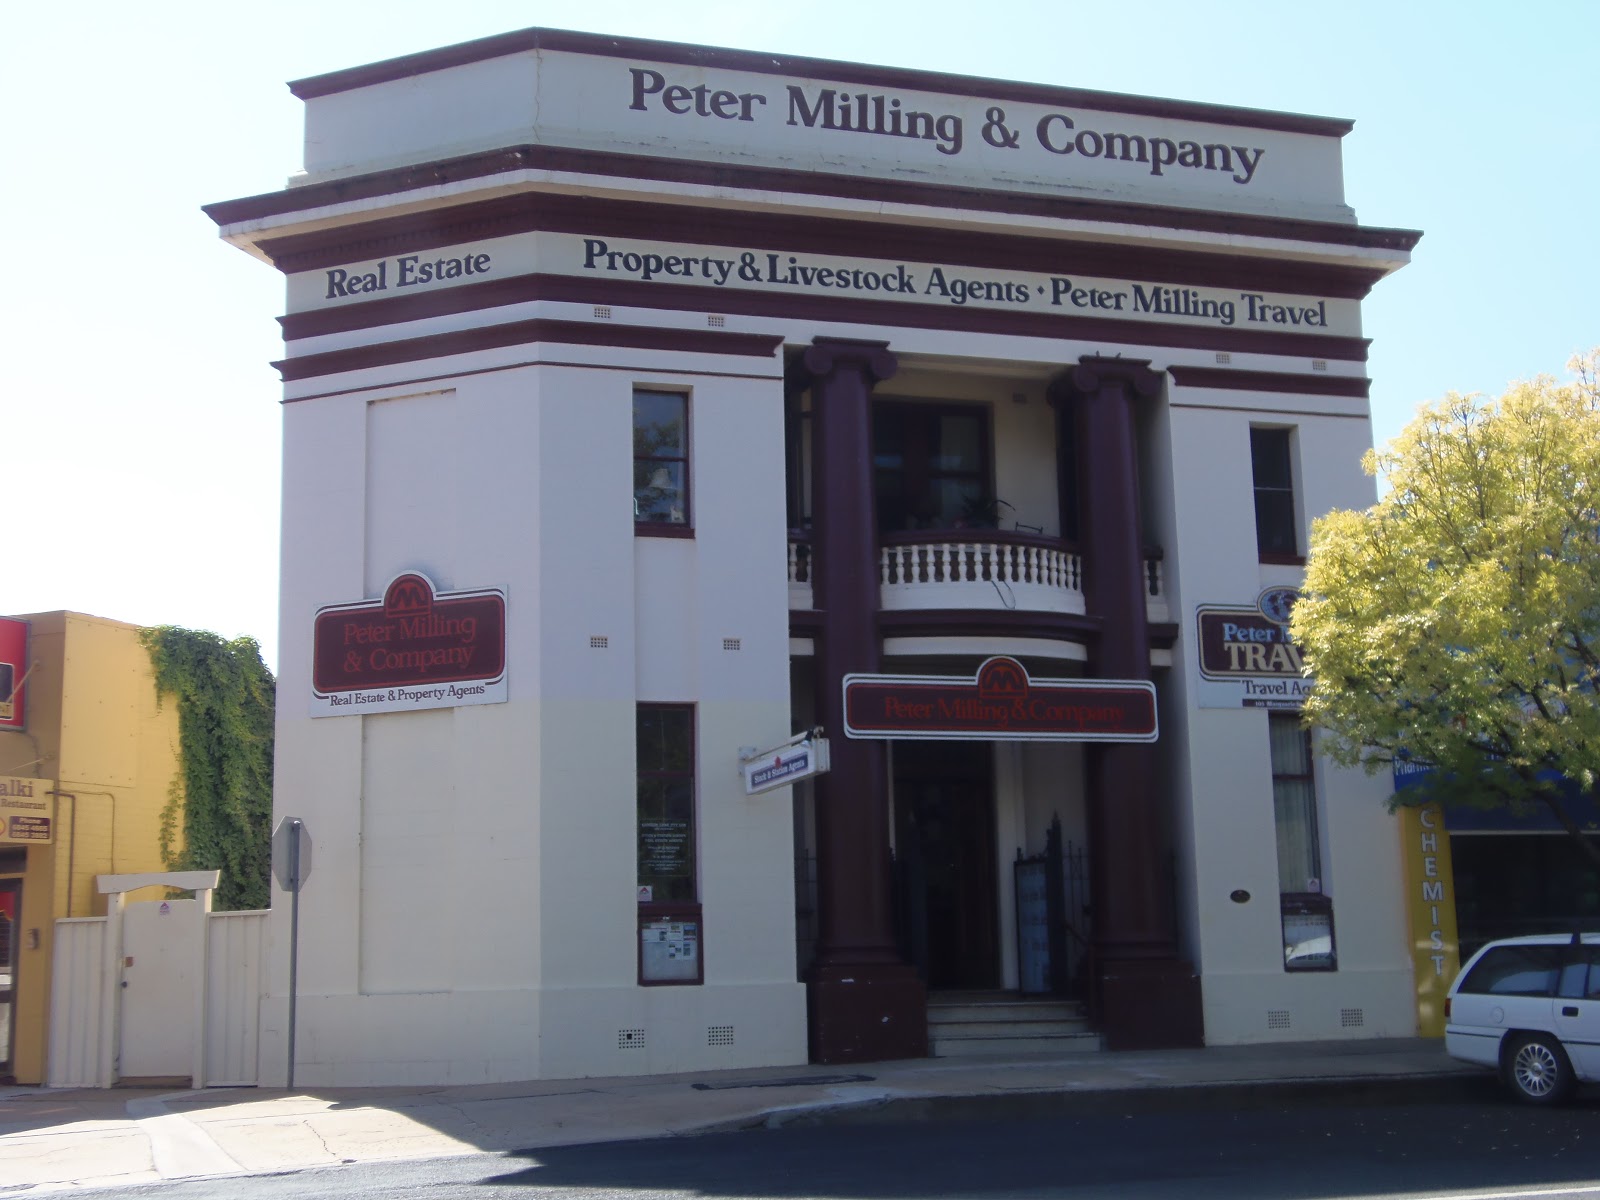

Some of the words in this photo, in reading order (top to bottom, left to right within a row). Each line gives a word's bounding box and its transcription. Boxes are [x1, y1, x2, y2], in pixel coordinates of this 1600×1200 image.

[628, 67, 766, 122] Peter
[786, 85, 963, 155] Milling
[981, 106, 1020, 150] &
[1036, 114, 1265, 184] Company
[325, 261, 387, 299] Real
[396, 253, 491, 287] Estate
[583, 239, 735, 286] Property
[738, 252, 763, 282] &
[766, 254, 916, 294] Livestock
[924, 267, 1030, 304] Agents
[1050, 277, 1127, 311] Peter
[1131, 283, 1235, 324] Milling
[1241, 293, 1328, 326] Travel
[344, 623, 396, 645] Peter
[400, 614, 478, 643] Milling
[1222, 623, 1275, 642] Peter
[343, 652, 362, 673] &
[369, 646, 474, 672] Company
[1224, 642, 1304, 671] TRAV
[330, 695, 352, 707] Real
[354, 693, 385, 705] Estate
[388, 690, 396, 701] &
[398, 687, 445, 702] Property
[447, 685, 485, 700] Agents
[1242, 680, 1288, 695] Travel
[884, 696, 934, 719] Peter
[938, 698, 1009, 728] Milling
[1011, 698, 1028, 721] &
[1029, 700, 1125, 730] Company
[1, 799, 46, 810] Restaurant
[1420, 808, 1445, 977] CHEMIST
